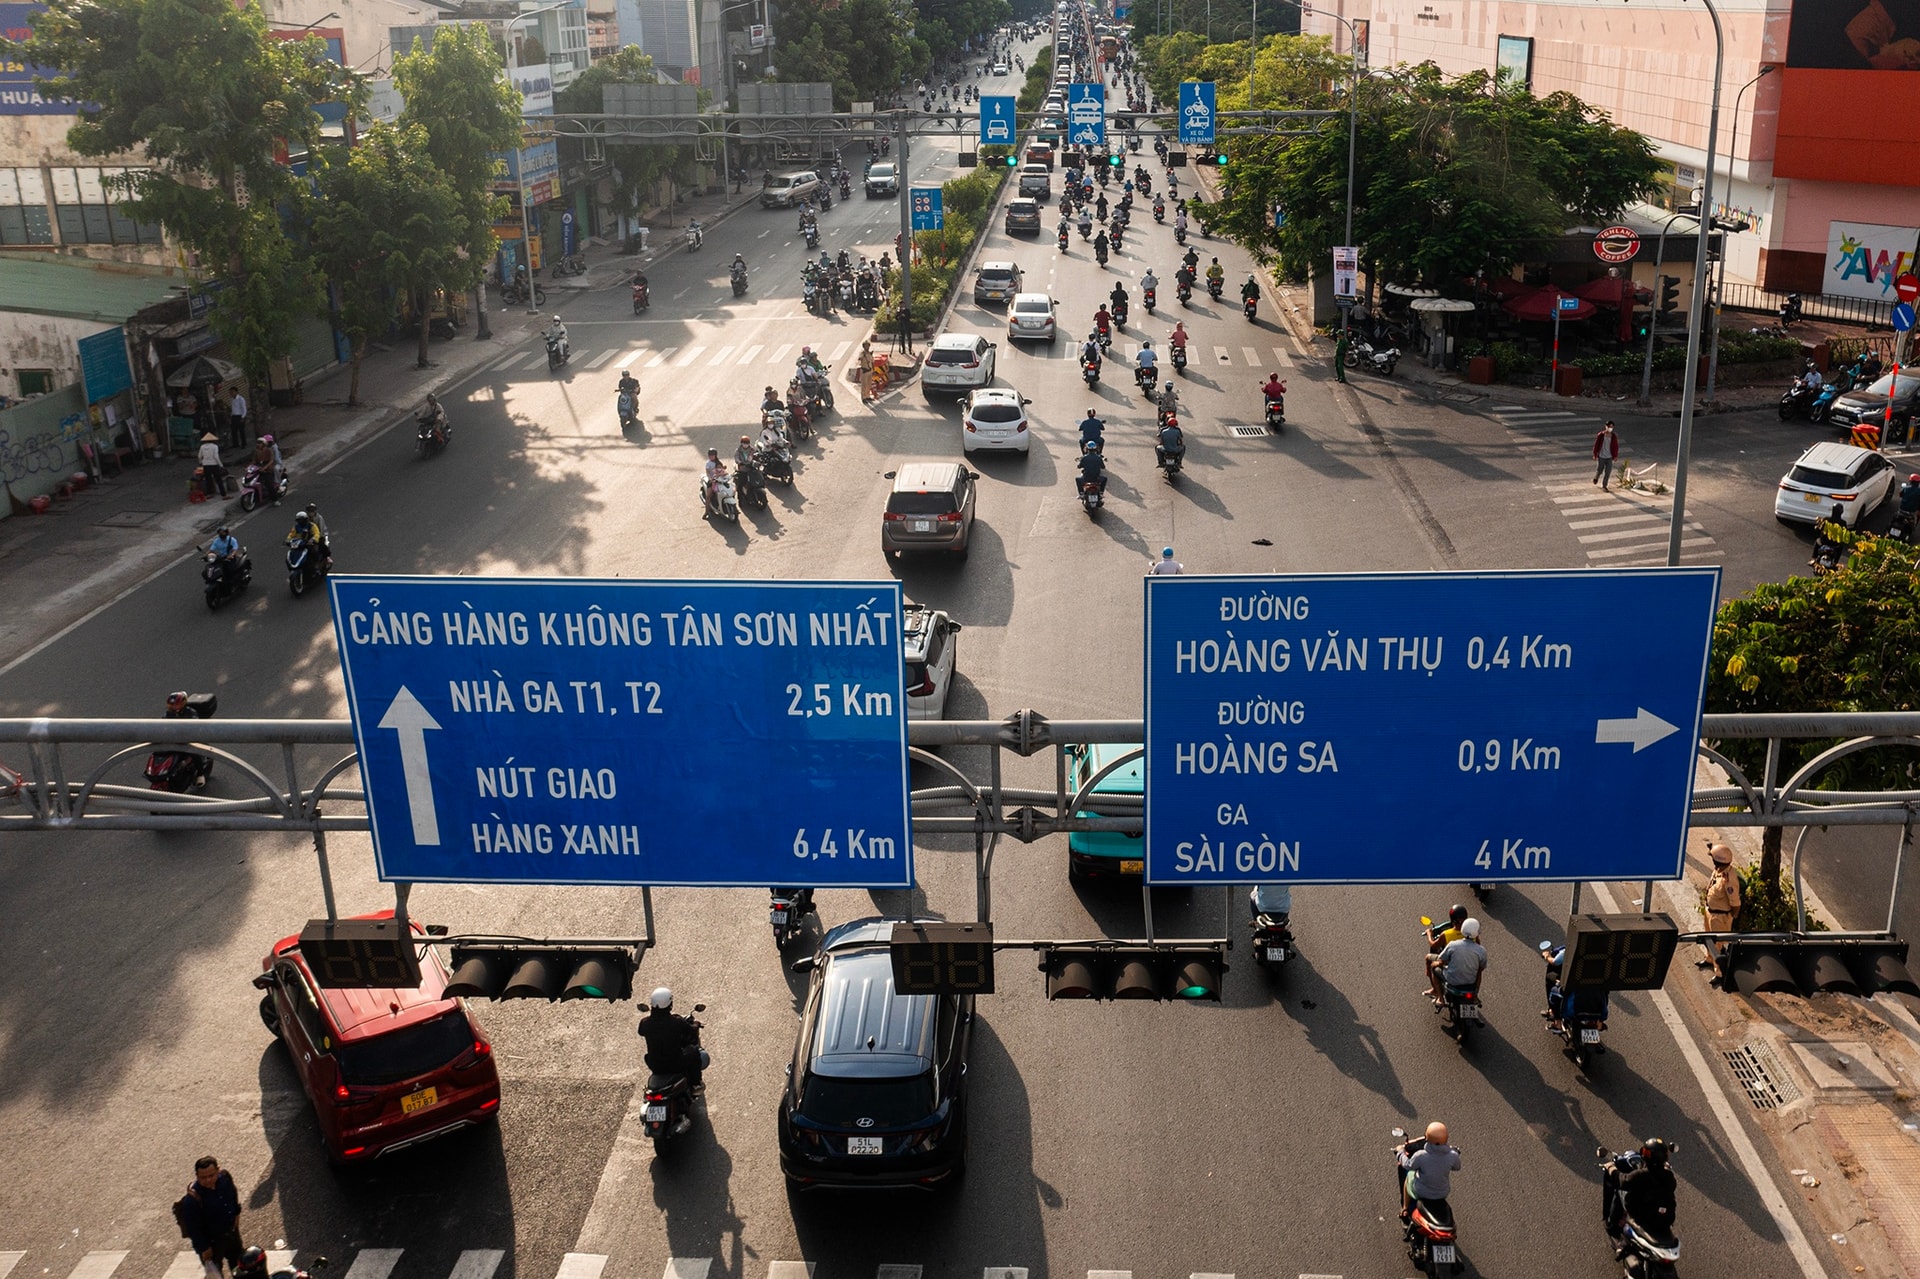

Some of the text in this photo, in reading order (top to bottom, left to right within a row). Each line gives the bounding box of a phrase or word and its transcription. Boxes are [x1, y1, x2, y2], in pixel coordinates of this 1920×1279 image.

[1600, 251, 1632, 261] COFFEE
[349, 596, 892, 646] CẢNG HÀNG KHÔNG TÂN SƠN NHẤT
[1219, 590, 1309, 621] ĐƯỜNG
[1176, 630, 1572, 677] HOÀNG VĂN THỤ 0,4 Km
[450, 670, 892, 718] NHÀ GA T1, T2 2,5 Km
[1217, 694, 1305, 725] ĐƯỜNG
[1176, 733, 1561, 774] HOÀNG SA 0,9 Km
[476, 756, 617, 800] NÚT GIAO
[1217, 803, 1249, 825] GA
[471, 812, 895, 861] HÀNG XANH 6,4 Km
[1175, 833, 1551, 873] SÀI GÒN 4 Km
[406, 1096, 433, 1111] 017.87
[411, 1092, 426, 1102] 60E
[857, 1138, 873, 1146] 51L
